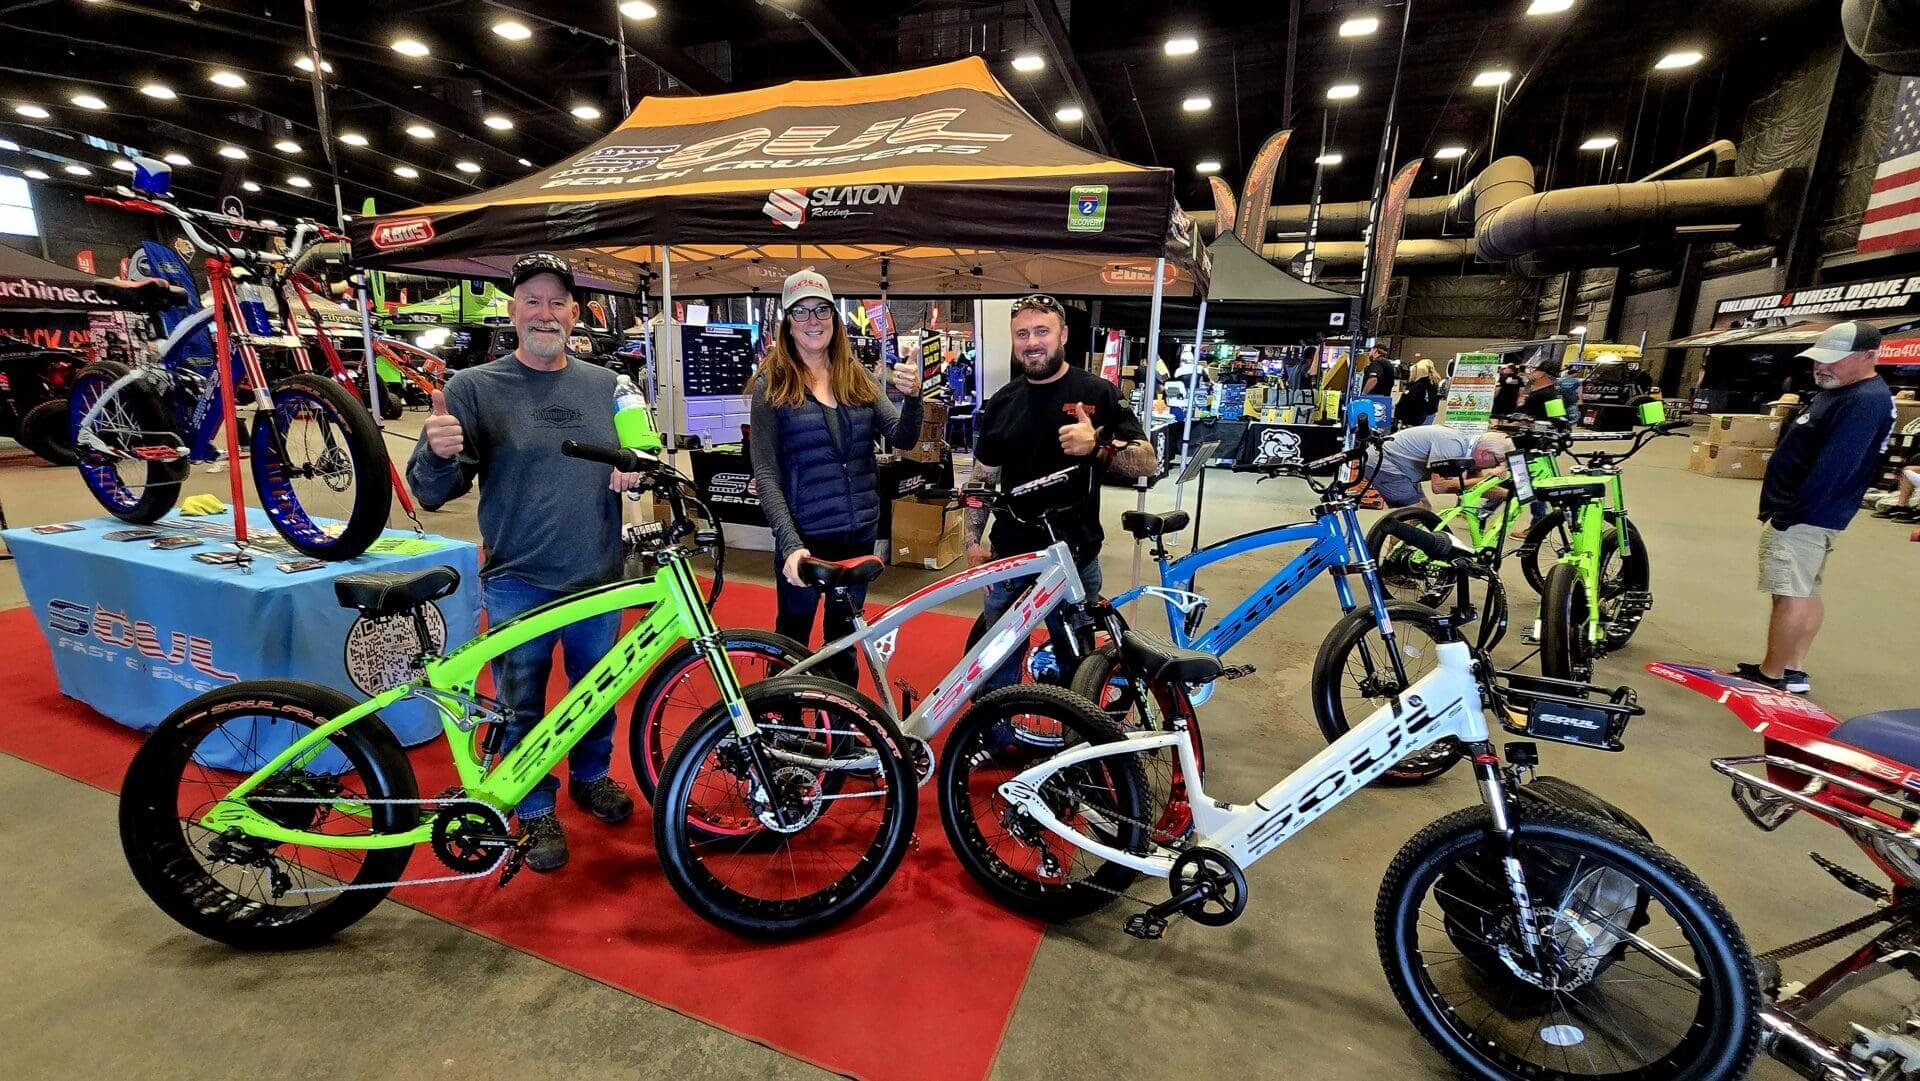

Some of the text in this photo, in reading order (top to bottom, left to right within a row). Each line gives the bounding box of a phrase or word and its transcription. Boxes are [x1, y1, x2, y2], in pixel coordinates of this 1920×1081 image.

[550, 108, 1013, 179] SOUL
[540, 143, 988, 189] BEACH CRUISERS
[810, 185, 904, 207] SLATON
[811, 208, 873, 219] Racing
[1083, 202, 1092, 214] 2
[379, 223, 428, 244] ABUS
[1071, 218, 1103, 226] RECOVERY
[1718, 294, 1783, 313] UNLIMITED
[1781, 292, 1794, 306] 4
[1792, 286, 1845, 306] WHEEL
[1843, 279, 1906, 300] DRIVE
[1752, 294, 1911, 320] ULTRA4RACING.COM
[1213, 547, 1338, 653] SOUL
[48, 598, 241, 685] SOUL
[58, 637, 224, 693] FAST E BIKE
[512, 613, 680, 784] SOUL
[1247, 697, 1464, 854] SOUL
